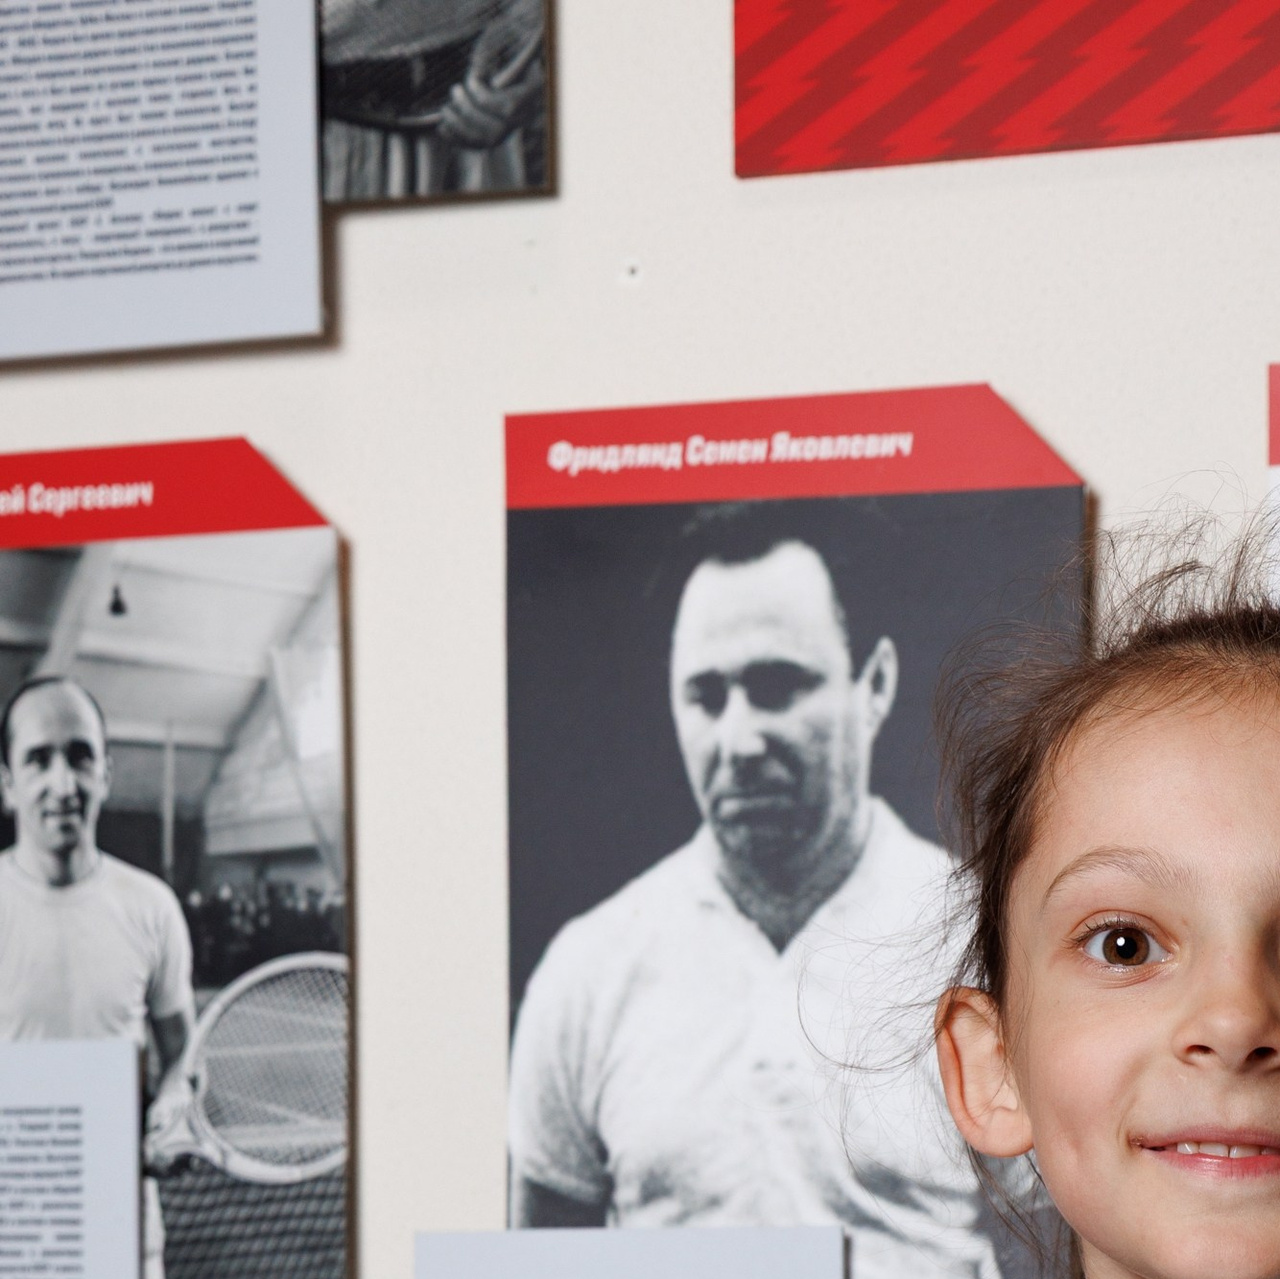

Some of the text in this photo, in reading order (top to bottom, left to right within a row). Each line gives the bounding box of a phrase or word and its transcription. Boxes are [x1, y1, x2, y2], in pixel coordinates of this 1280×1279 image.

[547, 431, 913, 477] Фридлянд Семен Яковлевич
[28, 481, 154, 518] Сергеевич
